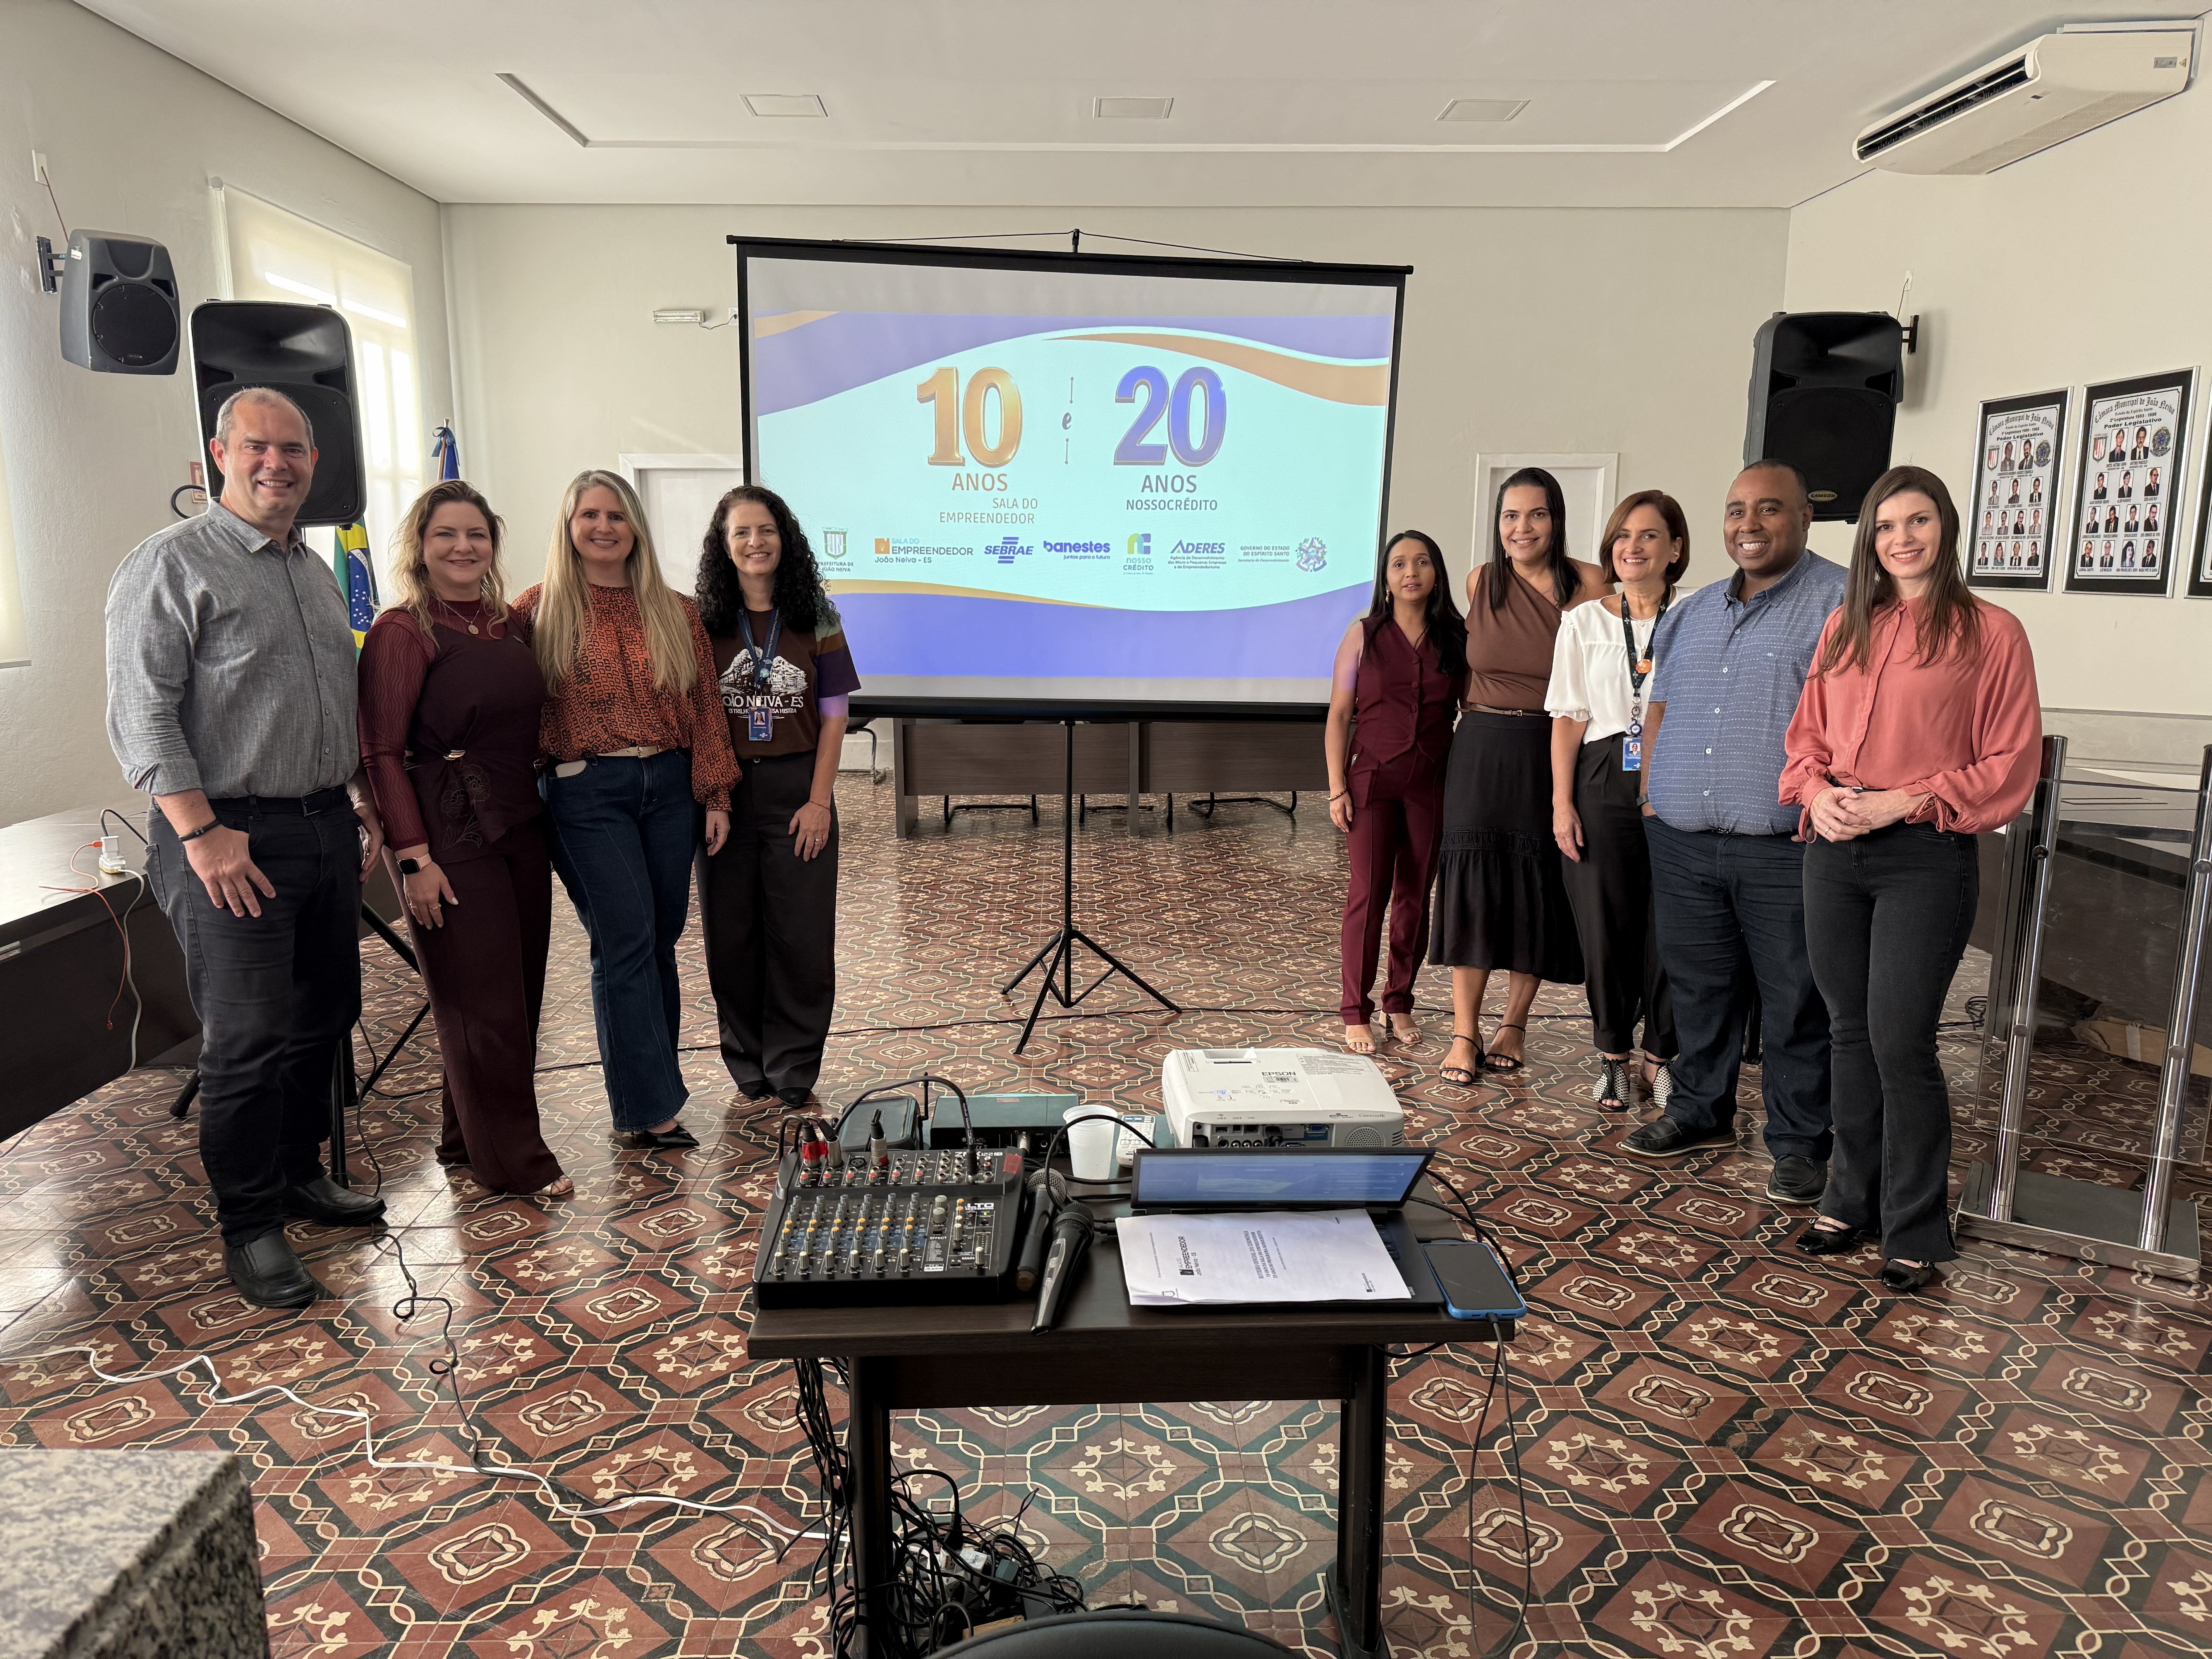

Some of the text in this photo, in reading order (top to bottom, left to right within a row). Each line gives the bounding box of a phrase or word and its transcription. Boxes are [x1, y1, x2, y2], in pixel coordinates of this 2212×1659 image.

[1113, 366, 1226, 467] 20
[2095, 406, 2113, 423] Câmara
[2114, 398, 2138, 411] Municipal
[2146, 397, 2158, 406] João
[917, 367, 1022, 468] 10
[1062, 412, 1072, 430] e
[2124, 418, 2162, 426] Legislativo
[952, 473, 1008, 491] ANOS
[1141, 475, 1197, 493] ANOS
[993, 498, 1038, 509] SALA DO
[1126, 498, 1218, 510] NOSSOCRÉDITO
[940, 512, 1035, 524] EMPREENDEDOR
[892, 546, 973, 556] EMPREENDEDOR
[984, 546, 1034, 555] SEBRAE
[1043, 541, 1111, 553] banestes
[1170, 539, 1225, 554] ADERES
[722, 694, 744, 707] OÃO
[791, 696, 804, 708] ES
